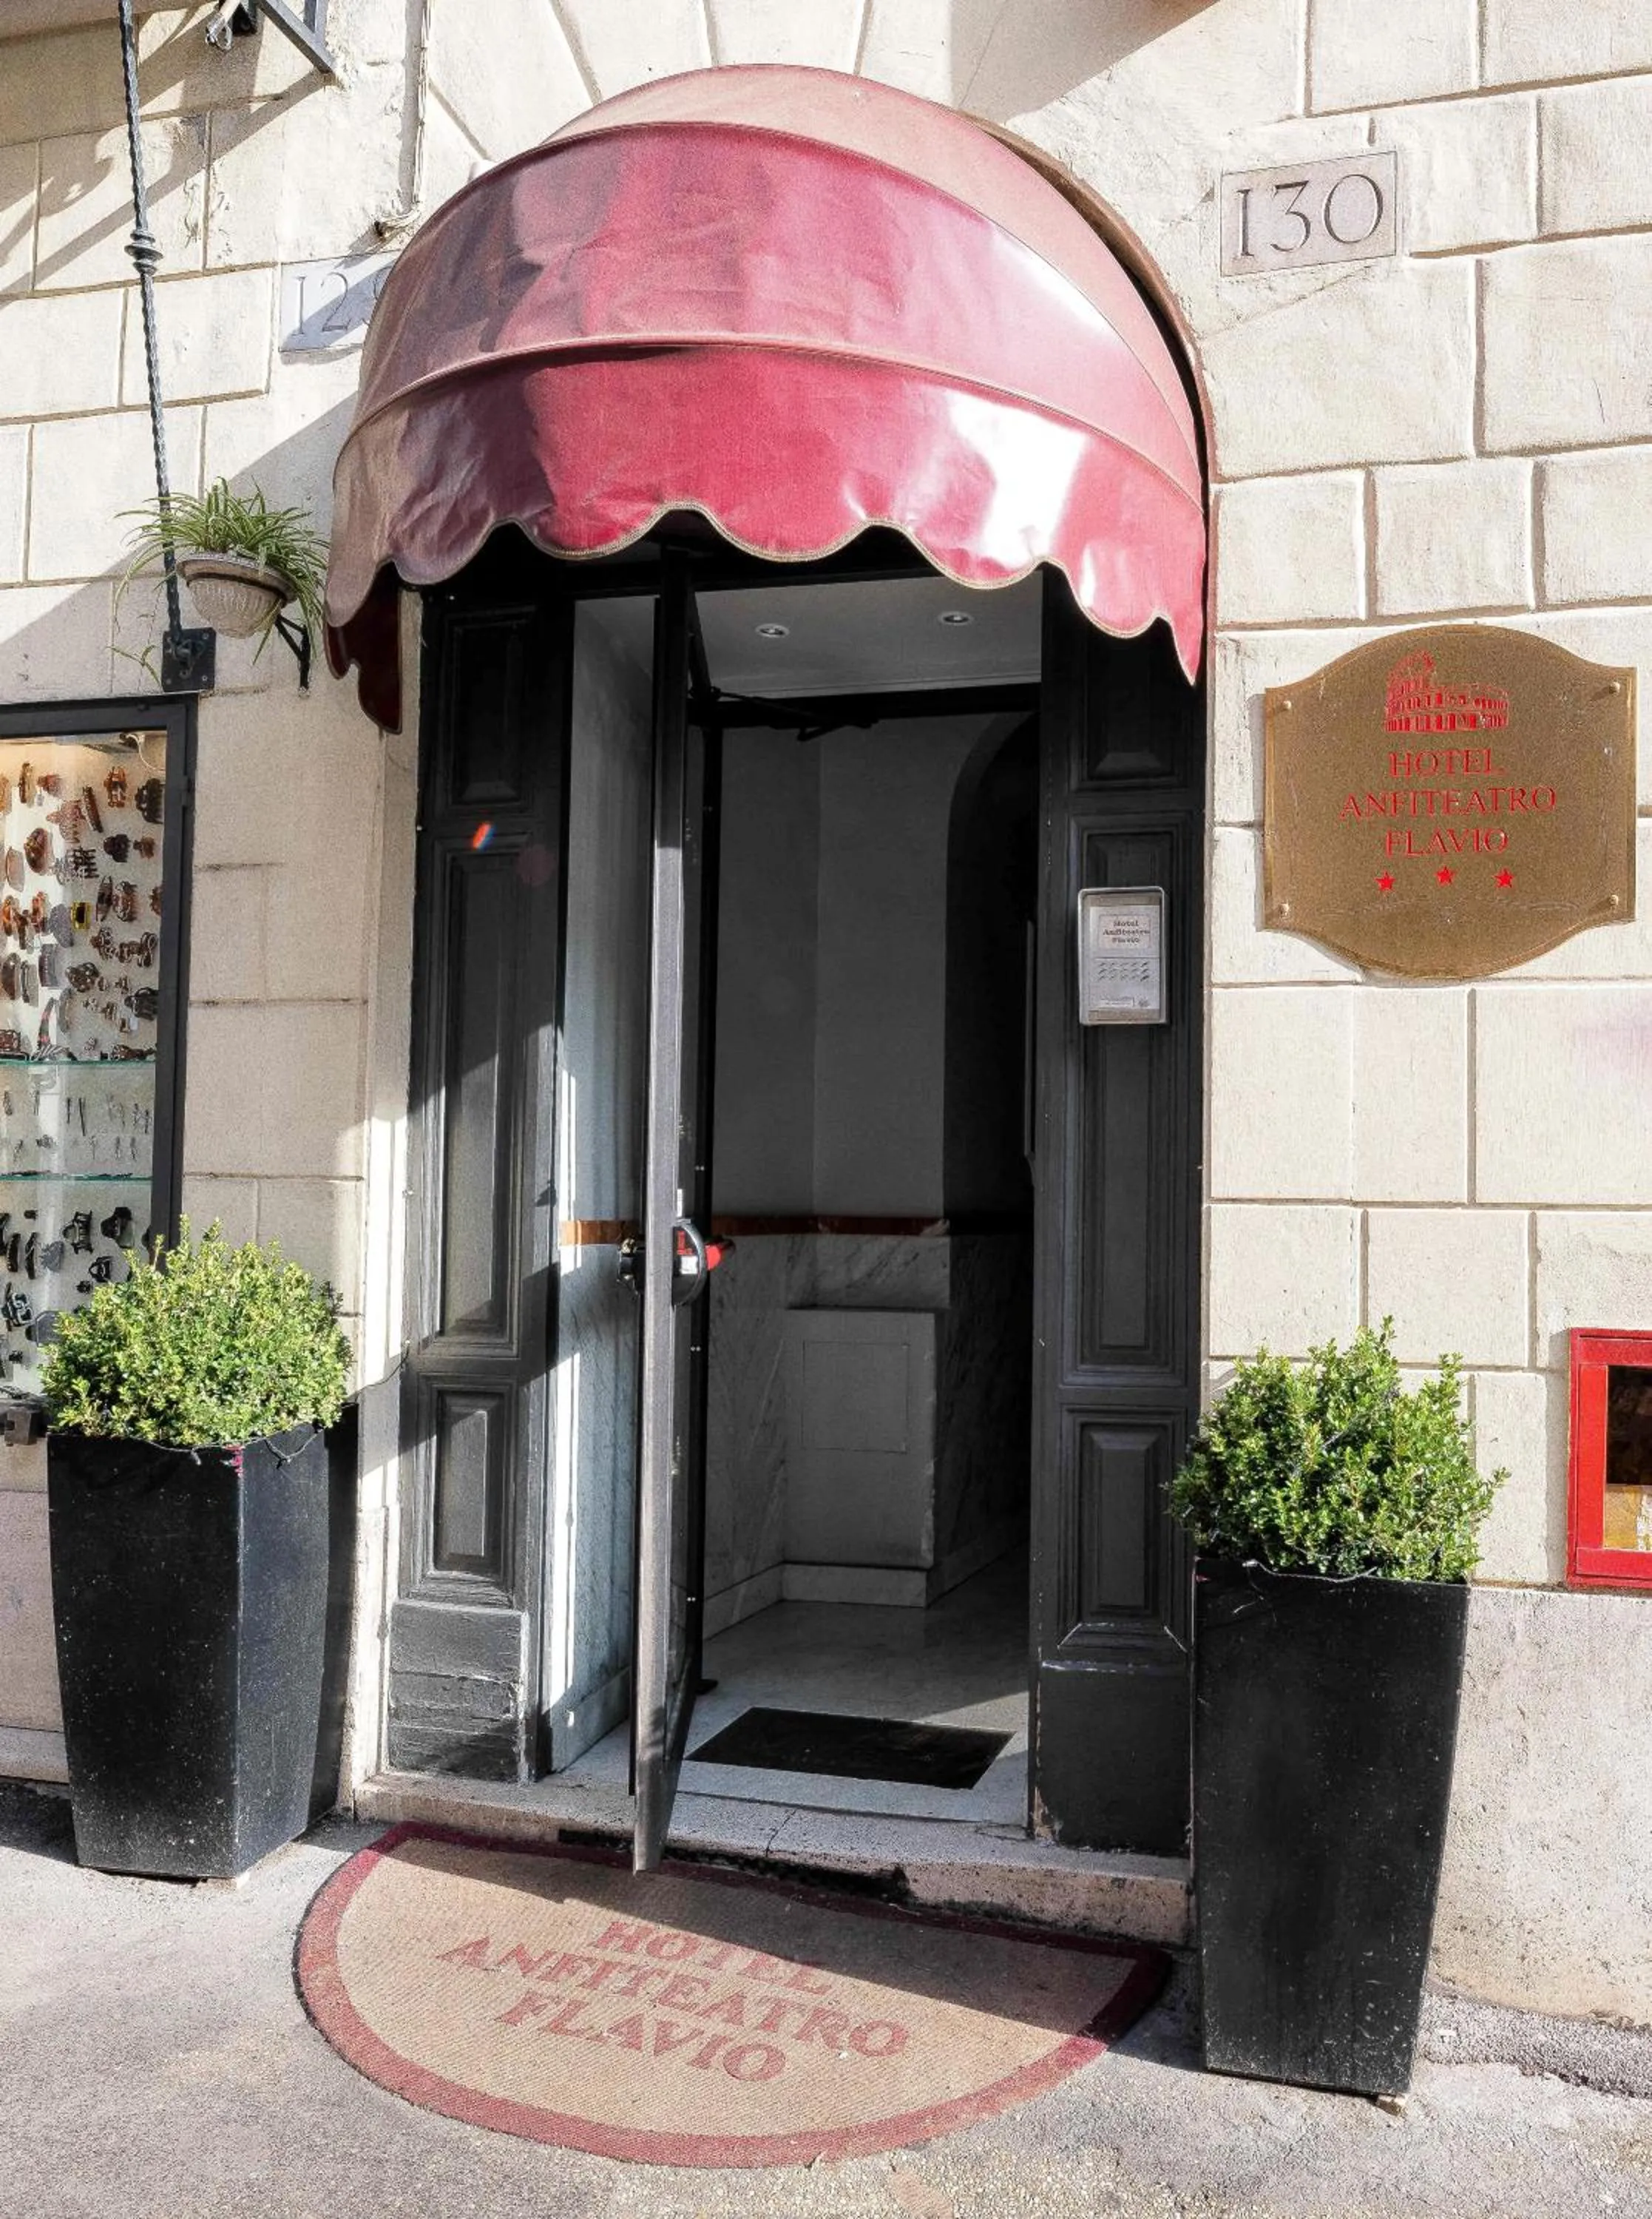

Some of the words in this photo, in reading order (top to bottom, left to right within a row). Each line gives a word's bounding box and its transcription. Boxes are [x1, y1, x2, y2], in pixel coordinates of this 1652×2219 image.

[1232, 173, 1384, 257] 130
[1387, 748, 1506, 777] HOTEL
[1339, 786, 1557, 820] ANFITEATRO
[1384, 828, 1509, 858] FLAVIO
[592, 1921, 833, 1995] HOTEL
[438, 1936, 910, 2056] ANFITEATRO
[493, 1991, 786, 2081] FLAVIO
